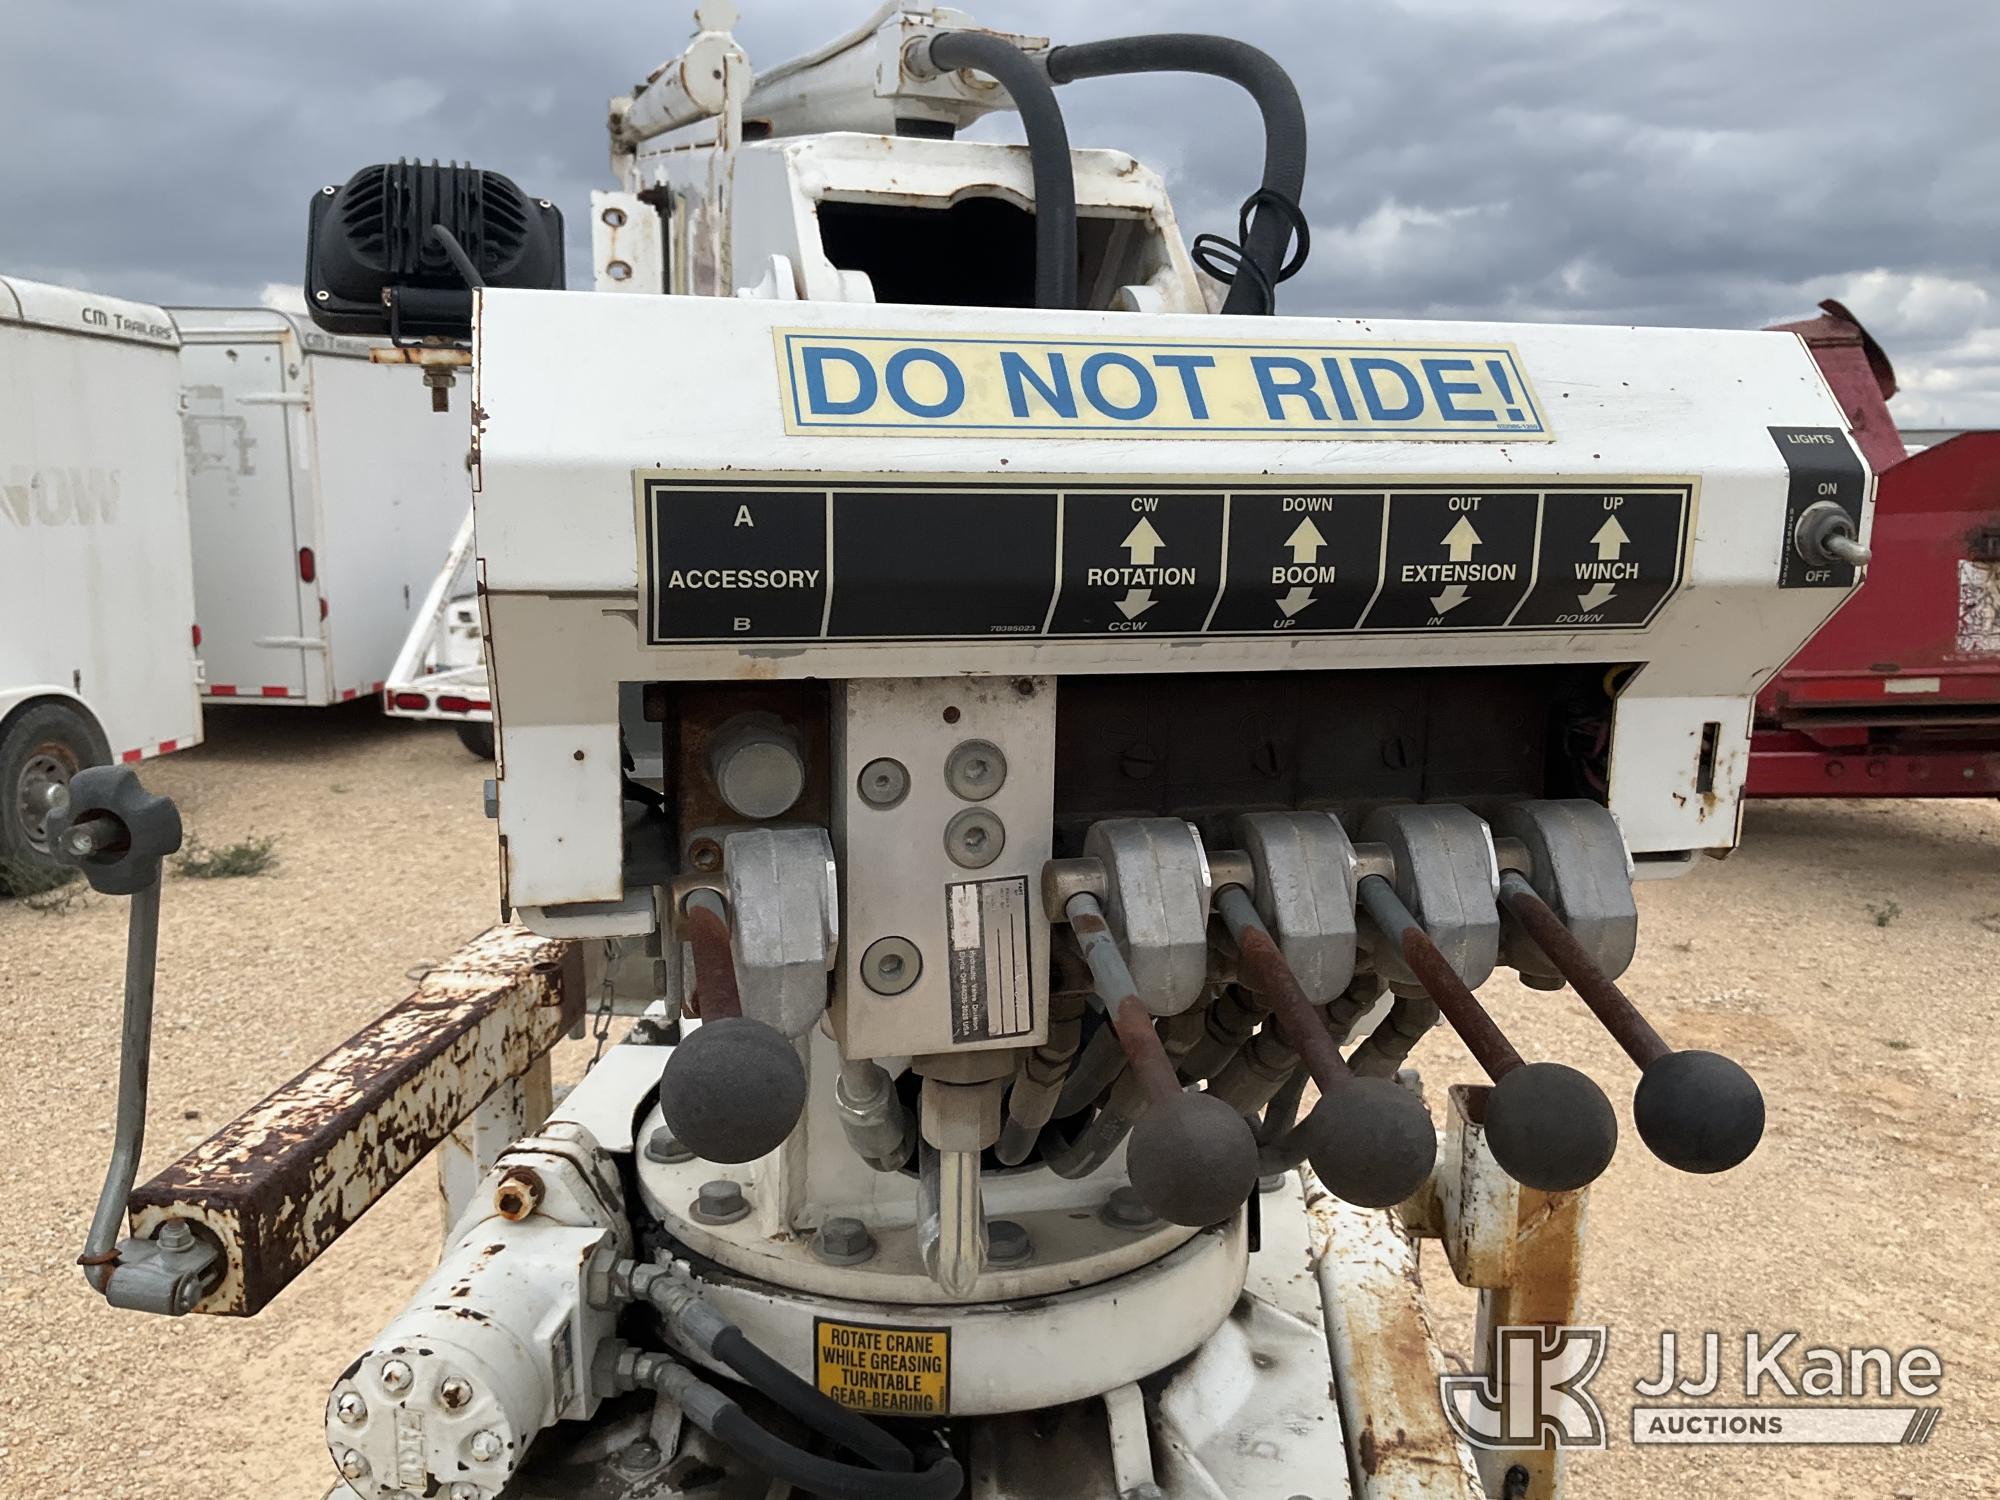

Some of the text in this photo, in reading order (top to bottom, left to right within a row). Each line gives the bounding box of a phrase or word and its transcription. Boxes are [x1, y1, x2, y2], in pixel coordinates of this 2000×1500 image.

[802, 347, 1526, 421] DO NOT RIDE!
[1787, 434, 1835, 444] LIGHTS
[1817, 482, 1837, 495] ON
[1131, 498, 1158, 512] CW
[1282, 497, 1333, 512] DOWN
[1448, 497, 1481, 511] OUT
[1603, 497, 1624, 510] UP
[734, 505, 754, 527] A
[1088, 567, 1196, 587] ROTATION
[1271, 566, 1335, 585] BOOM
[1401, 563, 1516, 583] EXTENSION
[1574, 562, 1639, 580] WINCH
[1805, 570, 1831, 582] OFF
[669, 569, 820, 589] ACCESSORY
[733, 617, 751, 632] B
[1108, 621, 1148, 631] CCW
[1272, 618, 1296, 629] UP
[1426, 616, 1445, 626] IN
[1555, 613, 1604, 624] DOWN
[831, 1328, 933, 1353] ROTATE CRANE
[823, 1346, 941, 1373] WHILE GREASING
[841, 1369, 921, 1392] TURNTABLE
[830, 1386, 933, 1411] GEAR-BEARING
